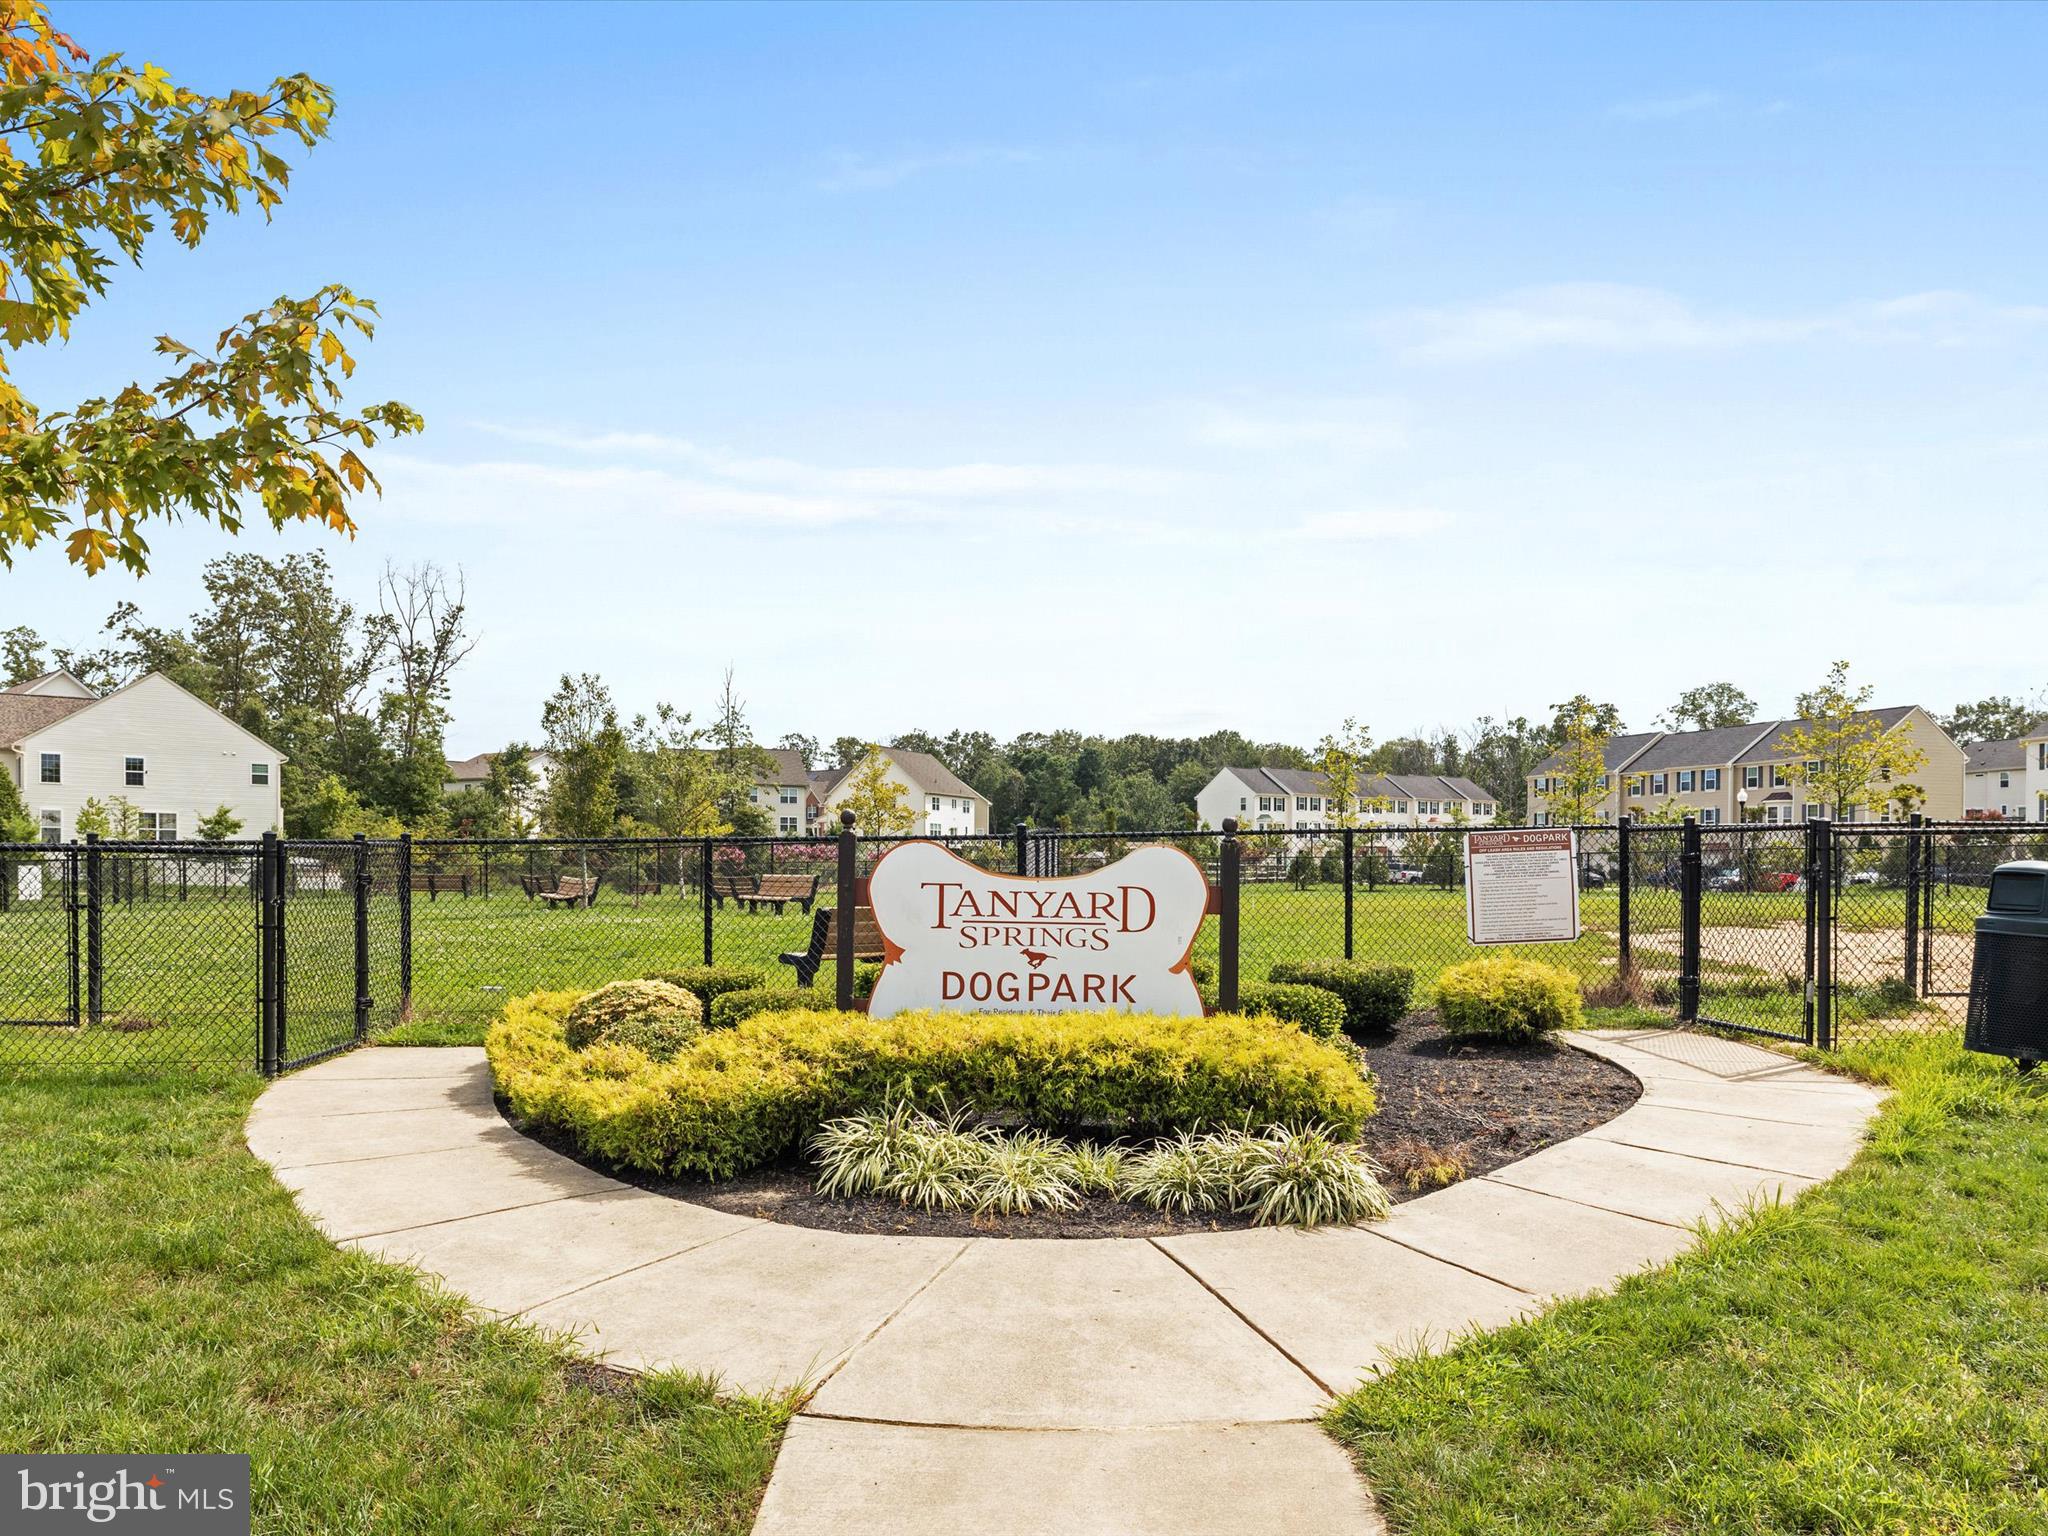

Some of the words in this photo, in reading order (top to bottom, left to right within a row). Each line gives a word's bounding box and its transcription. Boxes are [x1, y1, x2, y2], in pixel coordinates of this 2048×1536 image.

[1472, 833, 1510, 844] TANYARD
[1523, 833, 1568, 843] DOGPARK
[921, 882, 1156, 933] TANYARD
[958, 925, 1109, 951] SPRINGS
[942, 971, 1137, 1004] DOGPARK
